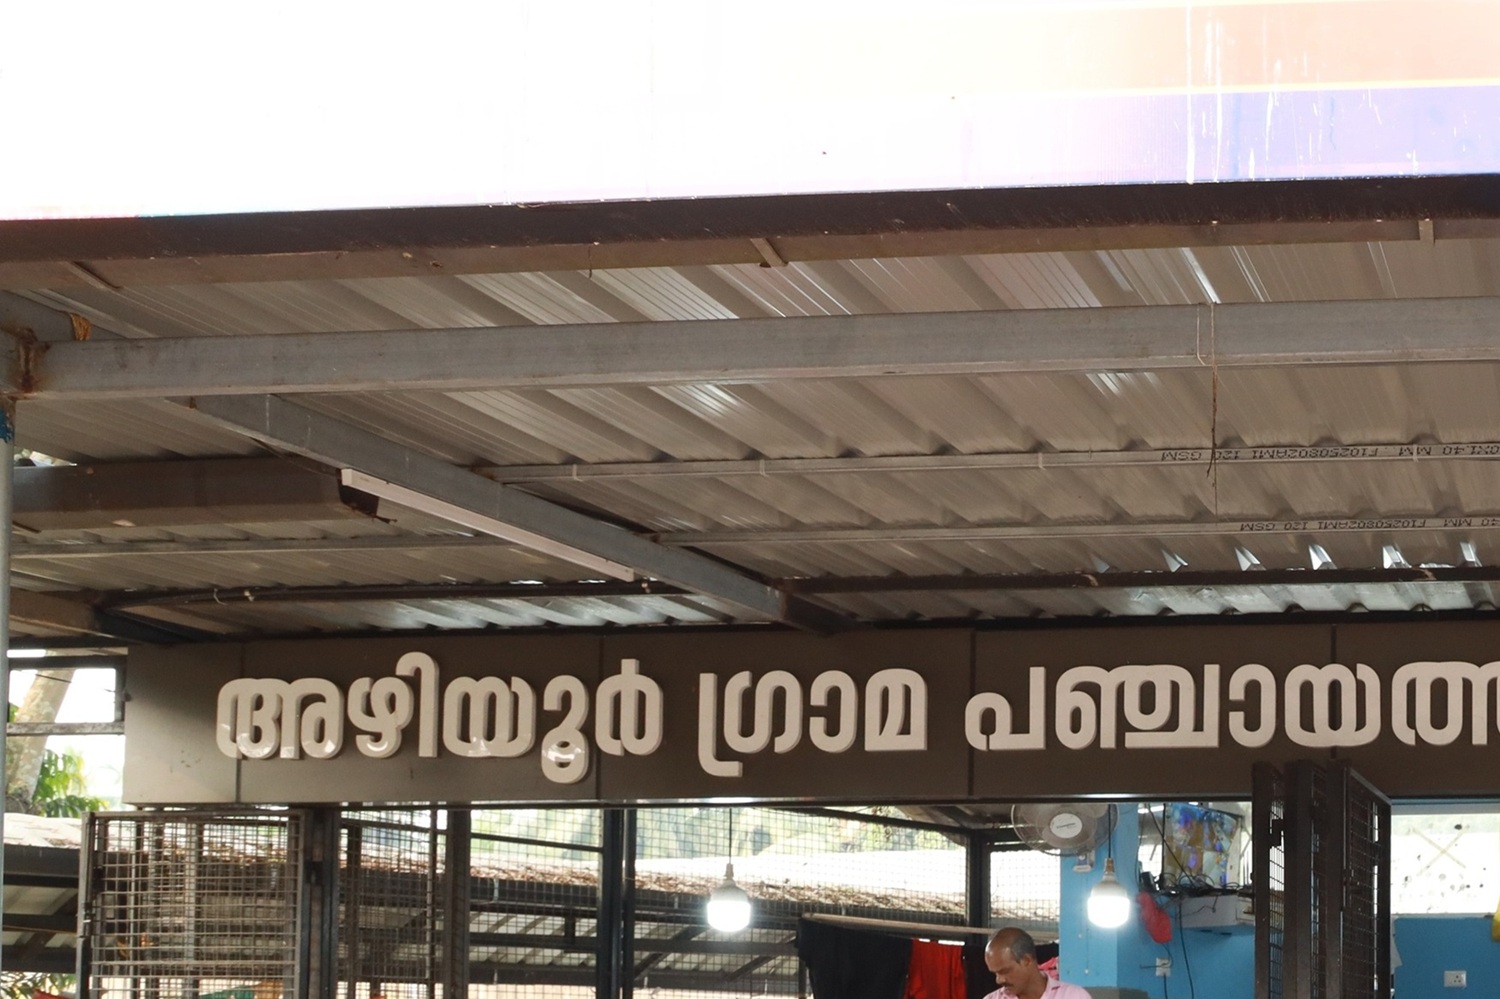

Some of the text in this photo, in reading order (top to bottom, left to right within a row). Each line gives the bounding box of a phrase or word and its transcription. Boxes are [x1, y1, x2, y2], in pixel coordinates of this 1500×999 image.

[1160, 450, 1203, 461] GSM
[1239, 522, 1276, 532] GSM
[1284, 521, 1309, 531] 120
[1443, 518, 1472, 528] MM
[215, 650, 665, 785] അഴിയൂർ
[697, 667, 929, 777] ഗ്രാമ
